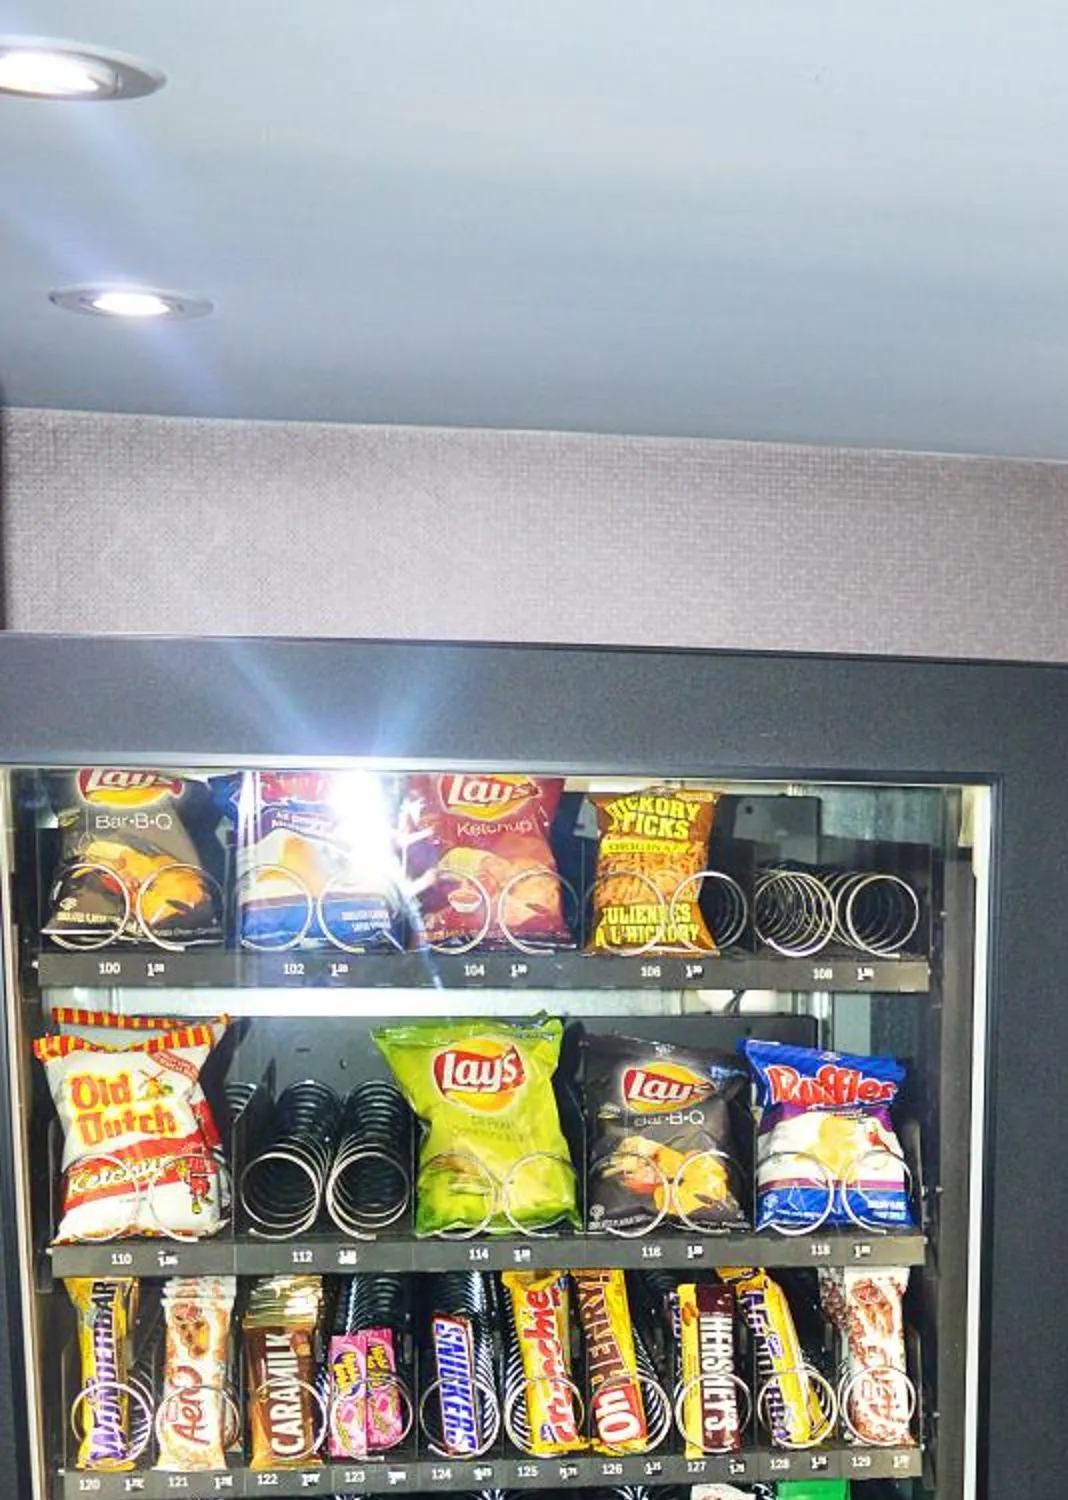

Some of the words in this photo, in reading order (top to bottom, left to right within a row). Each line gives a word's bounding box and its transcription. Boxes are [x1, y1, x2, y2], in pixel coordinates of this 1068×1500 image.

[605, 796, 700, 821] HICKORY
[457, 819, 534, 838] Ketchup
[608, 842, 686, 852] ORIGINA
[99, 962, 121, 975] 100
[284, 963, 304, 975] 102
[464, 965, 485, 976] 104
[766, 1064, 899, 1106] Ruffles
[70, 1072, 132, 1110] Old
[77, 1103, 179, 1146] Dutch
[111, 1254, 132, 1264] 110
[292, 1251, 313, 1262] 112
[434, 1321, 479, 1452] SNICKERS
[264, 1331, 305, 1456] CARAMILK
[517, 1466, 538, 1477] 125
[602, 1464, 622, 1474] 126
[687, 1462, 706, 1472] 127
[257, 1474, 278, 1485] 122
[345, 1472, 365, 1483] 123
[432, 1469, 452, 1480] 124
[169, 1476, 188, 1487] 121
